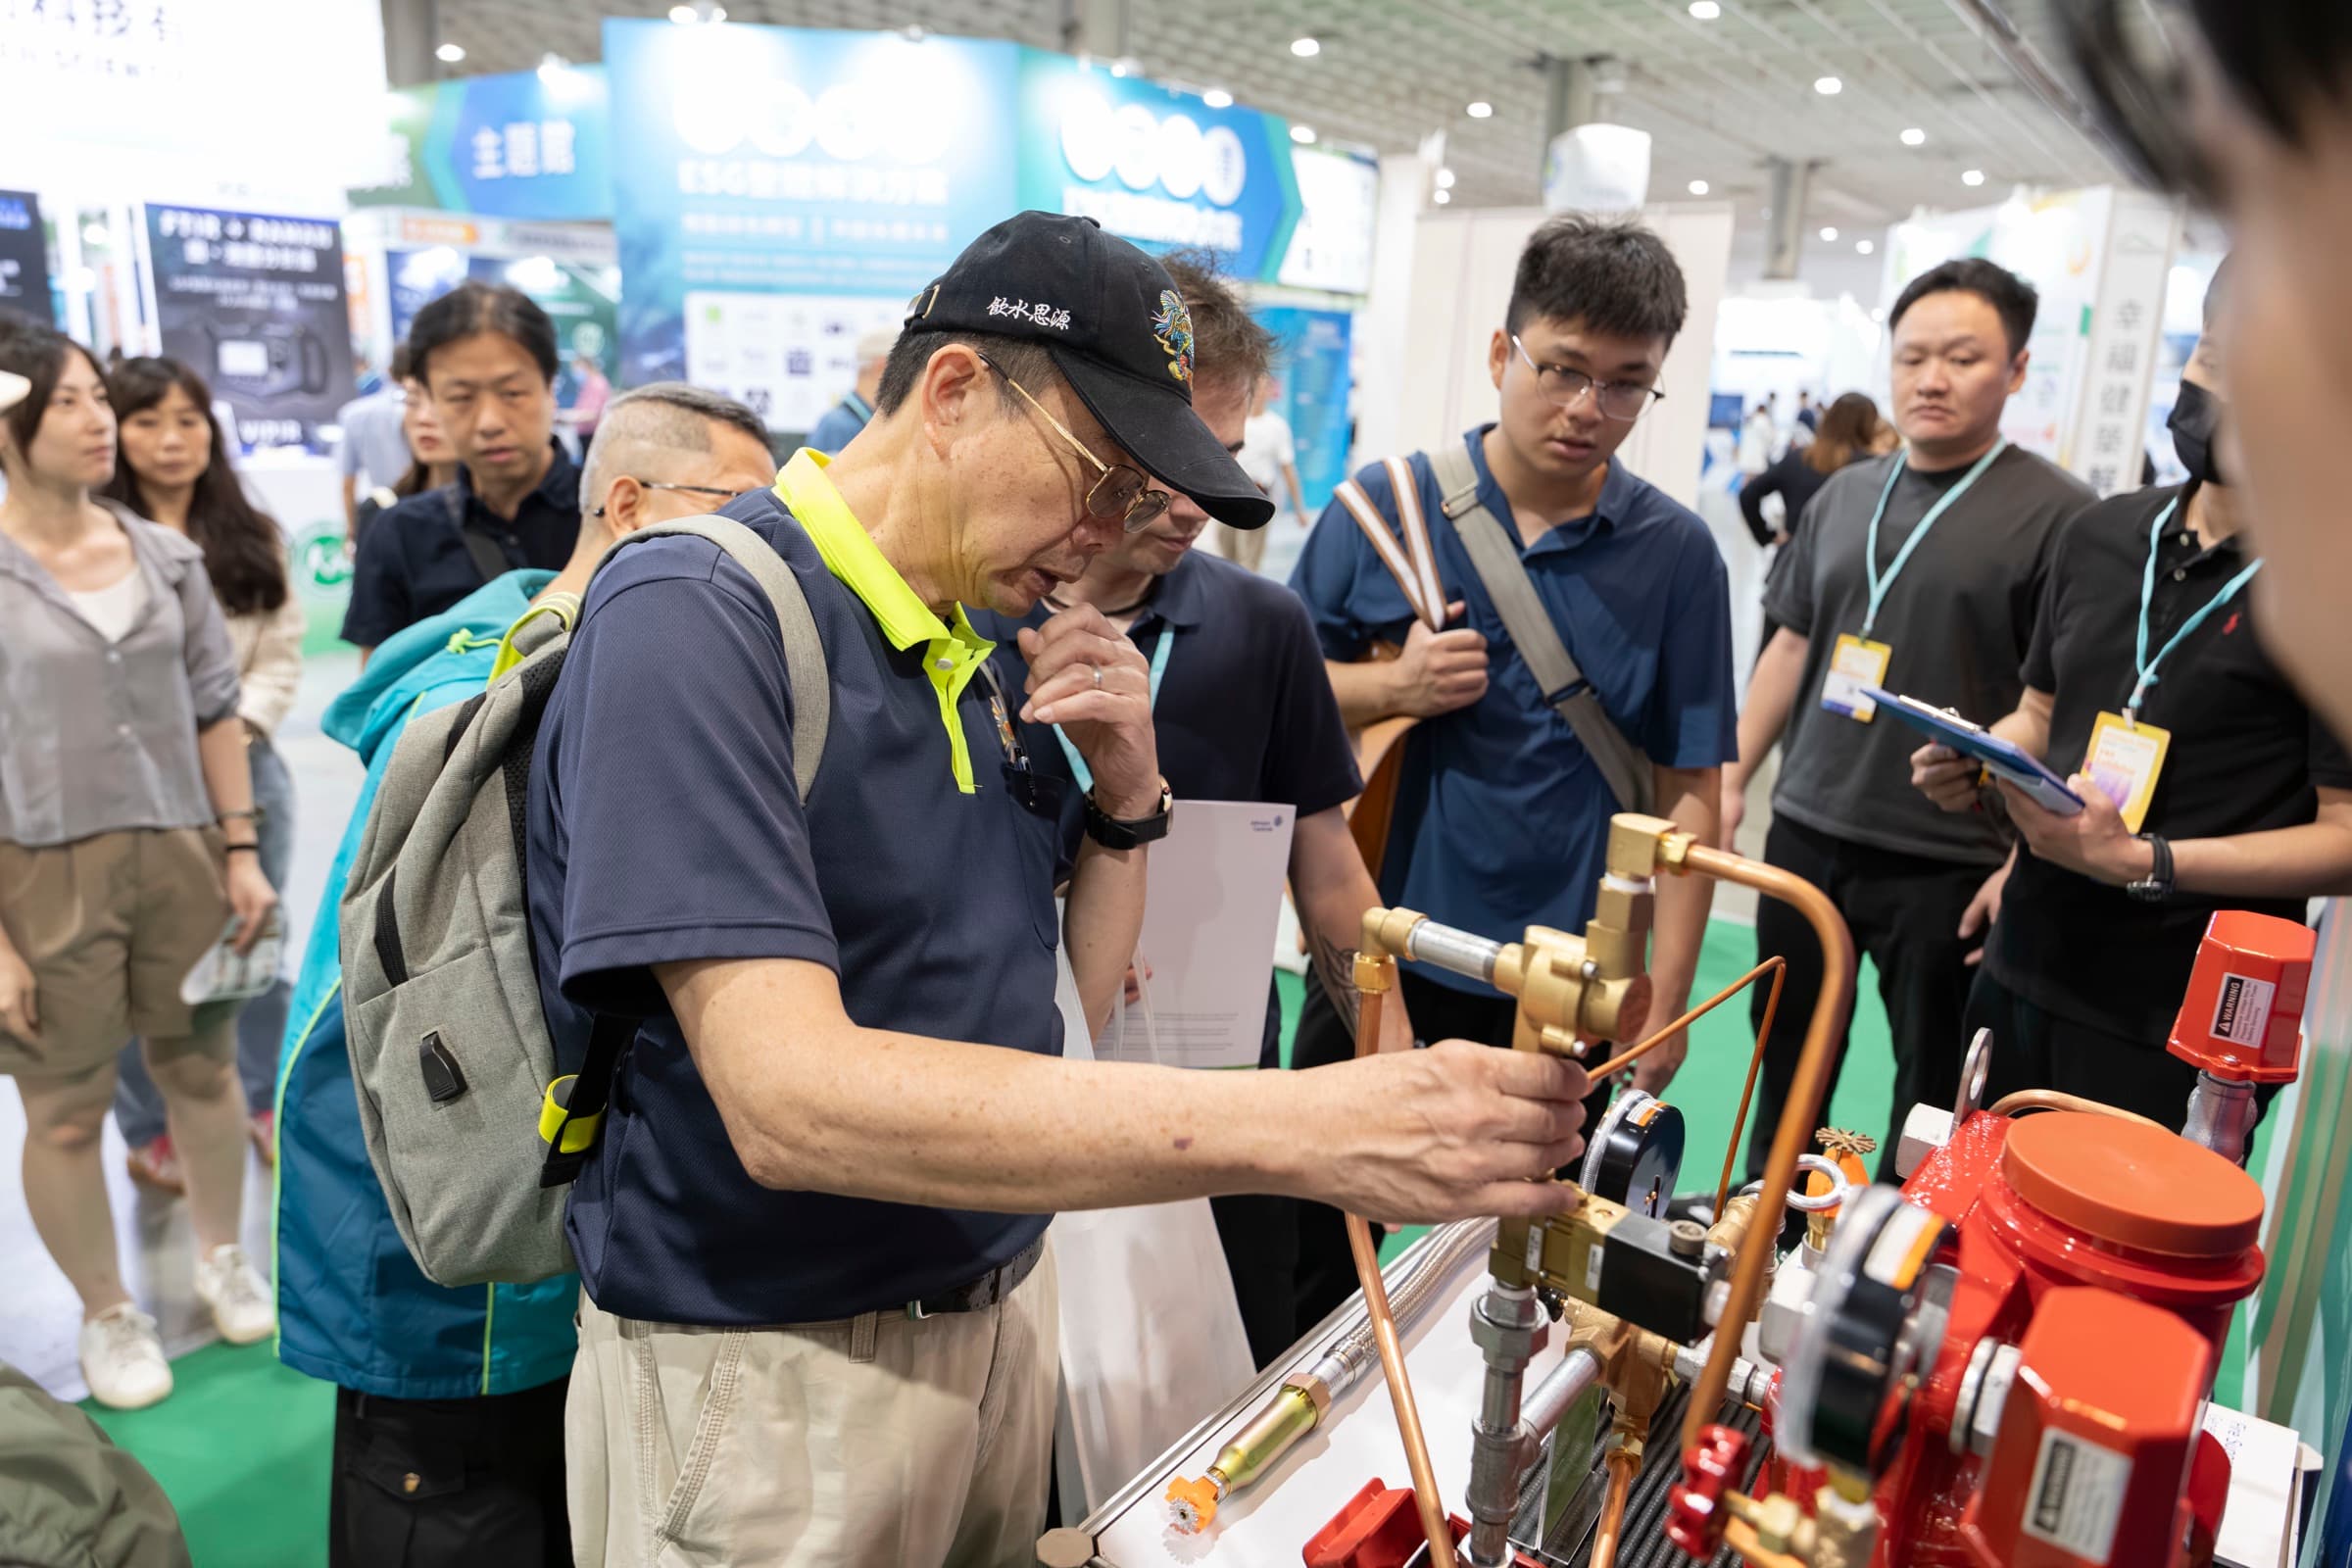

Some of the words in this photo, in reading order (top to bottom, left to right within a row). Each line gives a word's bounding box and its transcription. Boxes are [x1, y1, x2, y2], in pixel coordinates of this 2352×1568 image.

[986, 296, 1071, 330] 飲水思源
[2222, 982, 2241, 1021] WARNING
